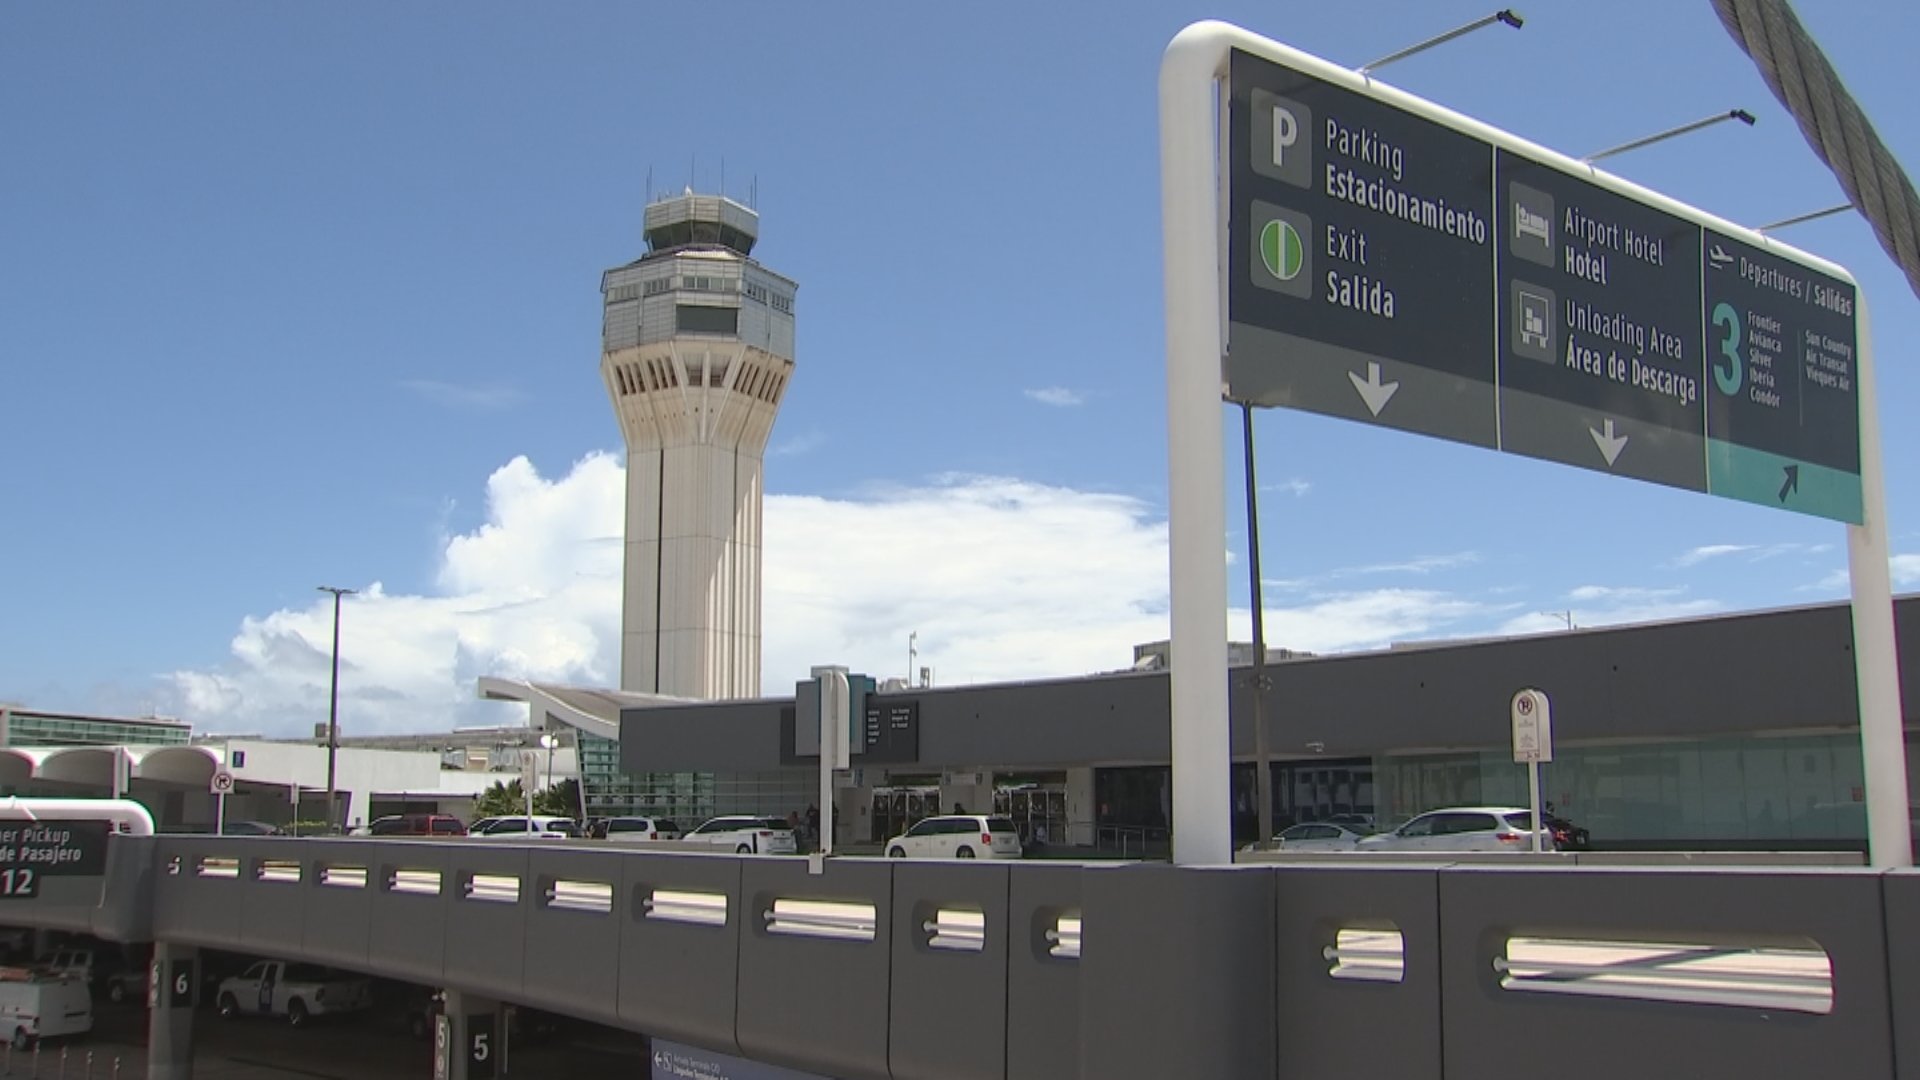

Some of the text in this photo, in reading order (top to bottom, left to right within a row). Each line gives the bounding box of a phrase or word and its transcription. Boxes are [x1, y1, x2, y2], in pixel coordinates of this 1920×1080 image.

[1272, 106, 1298, 167] P
[1326, 118, 1404, 181] Parking
[1326, 162, 1486, 245] Estacionamiento
[1326, 225, 1367, 266] Exit
[1564, 206, 1664, 267] Airport Hotel
[1564, 245, 1607, 285] Hotel
[1326, 270, 1396, 320] Salida
[1740, 257, 1853, 317] Departures / Salidas
[1565, 300, 1683, 360] Unloading Area
[1748, 312, 1782, 334] Frontier
[1712, 302, 1743, 396] 3
[1749, 331, 1782, 353] Avianca
[1806, 330, 1852, 361] Sun Country
[1565, 333, 1697, 406] Área de Descarga
[1750, 350, 1773, 368] Silver
[1805, 349, 1848, 375] Air Transat
[1750, 368, 1776, 388] Iberia
[1807, 367, 1851, 392] Vieques Air
[1751, 387, 1781, 408] Condor
[0, 827, 71, 846] er Pickup
[0, 845, 82, 865] de Pasajero
[2, 868, 34, 895] 12
[175, 972, 188, 995] 6
[438, 1022, 446, 1049] 5
[474, 1032, 489, 1061] 5
